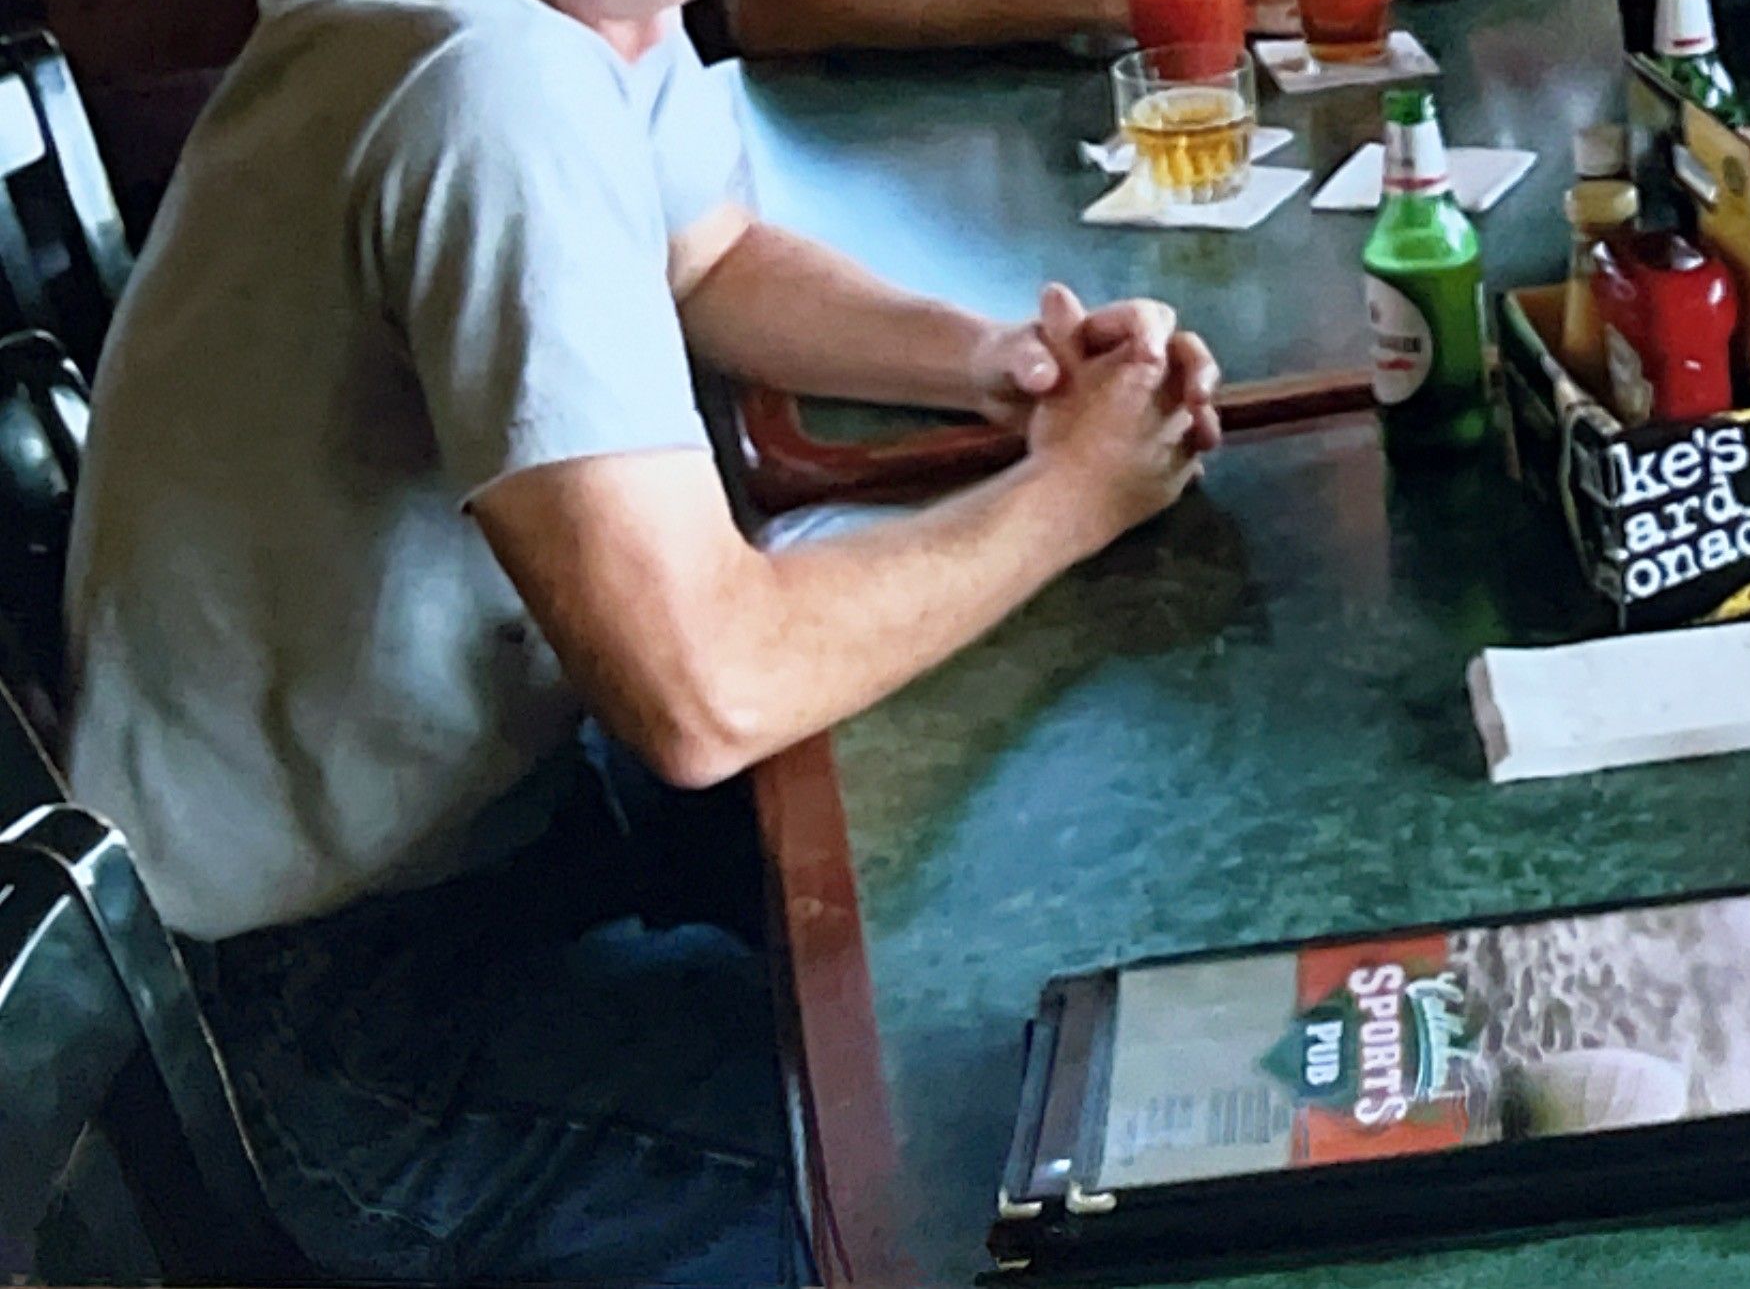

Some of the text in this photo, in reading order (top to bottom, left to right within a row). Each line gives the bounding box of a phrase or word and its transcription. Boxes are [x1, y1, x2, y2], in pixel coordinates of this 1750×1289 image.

[1600, 426, 1750, 507] ke's
[1612, 473, 1743, 559] ard
[1305, 1019, 1344, 1087] PUB
[1347, 963, 1408, 1125] SPORTS
